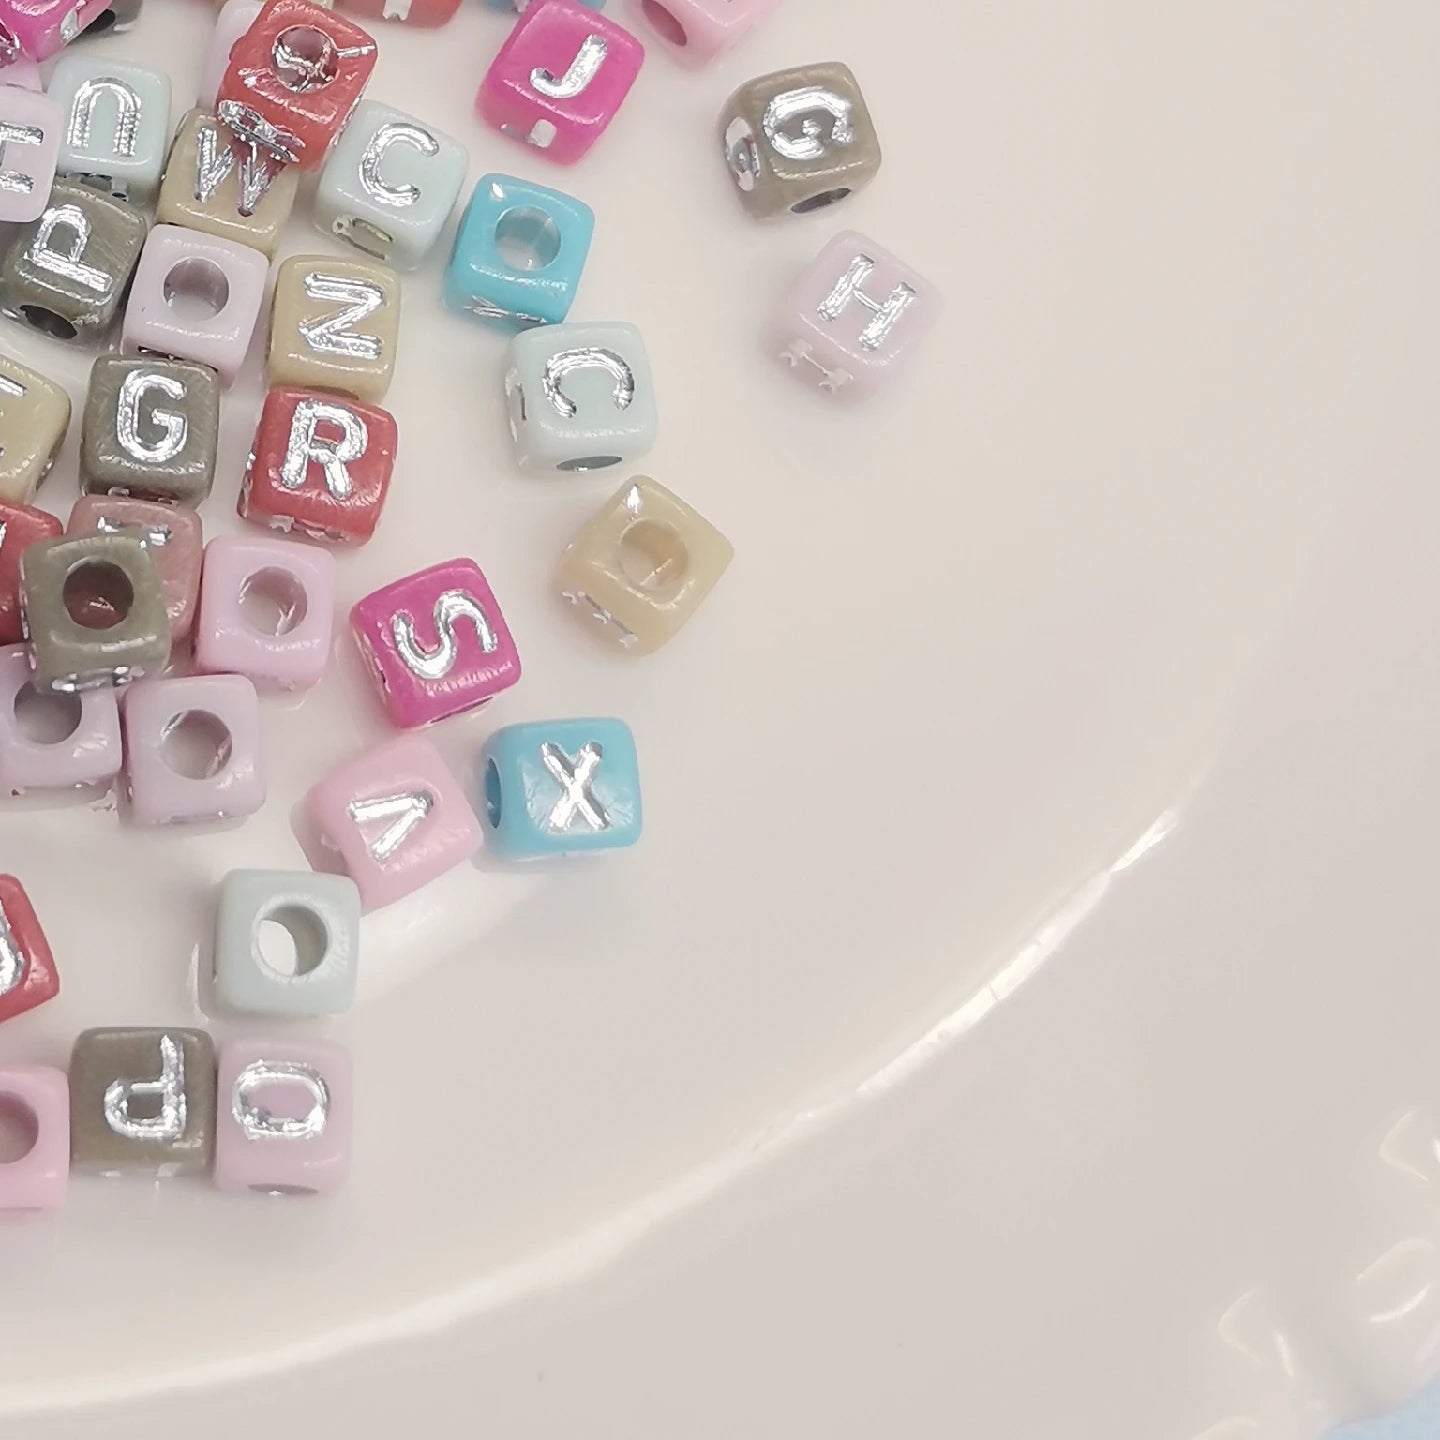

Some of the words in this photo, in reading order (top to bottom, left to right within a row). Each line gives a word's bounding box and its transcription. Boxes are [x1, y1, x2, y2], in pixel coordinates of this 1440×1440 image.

[530, 33, 608, 99] J
[66, 76, 143, 158] U
[763, 86, 854, 160] G
[359, 123, 440, 207] C
[26, 203, 113, 292] P
[816, 252, 917, 353] H
[118, 368, 189, 460] G
[543, 347, 636, 418] C
[280, 399, 369, 501] R
[393, 590, 497, 681] S
[349, 791, 435, 862] V
[540, 740, 613, 833] X
[104, 1034, 188, 1141] P
